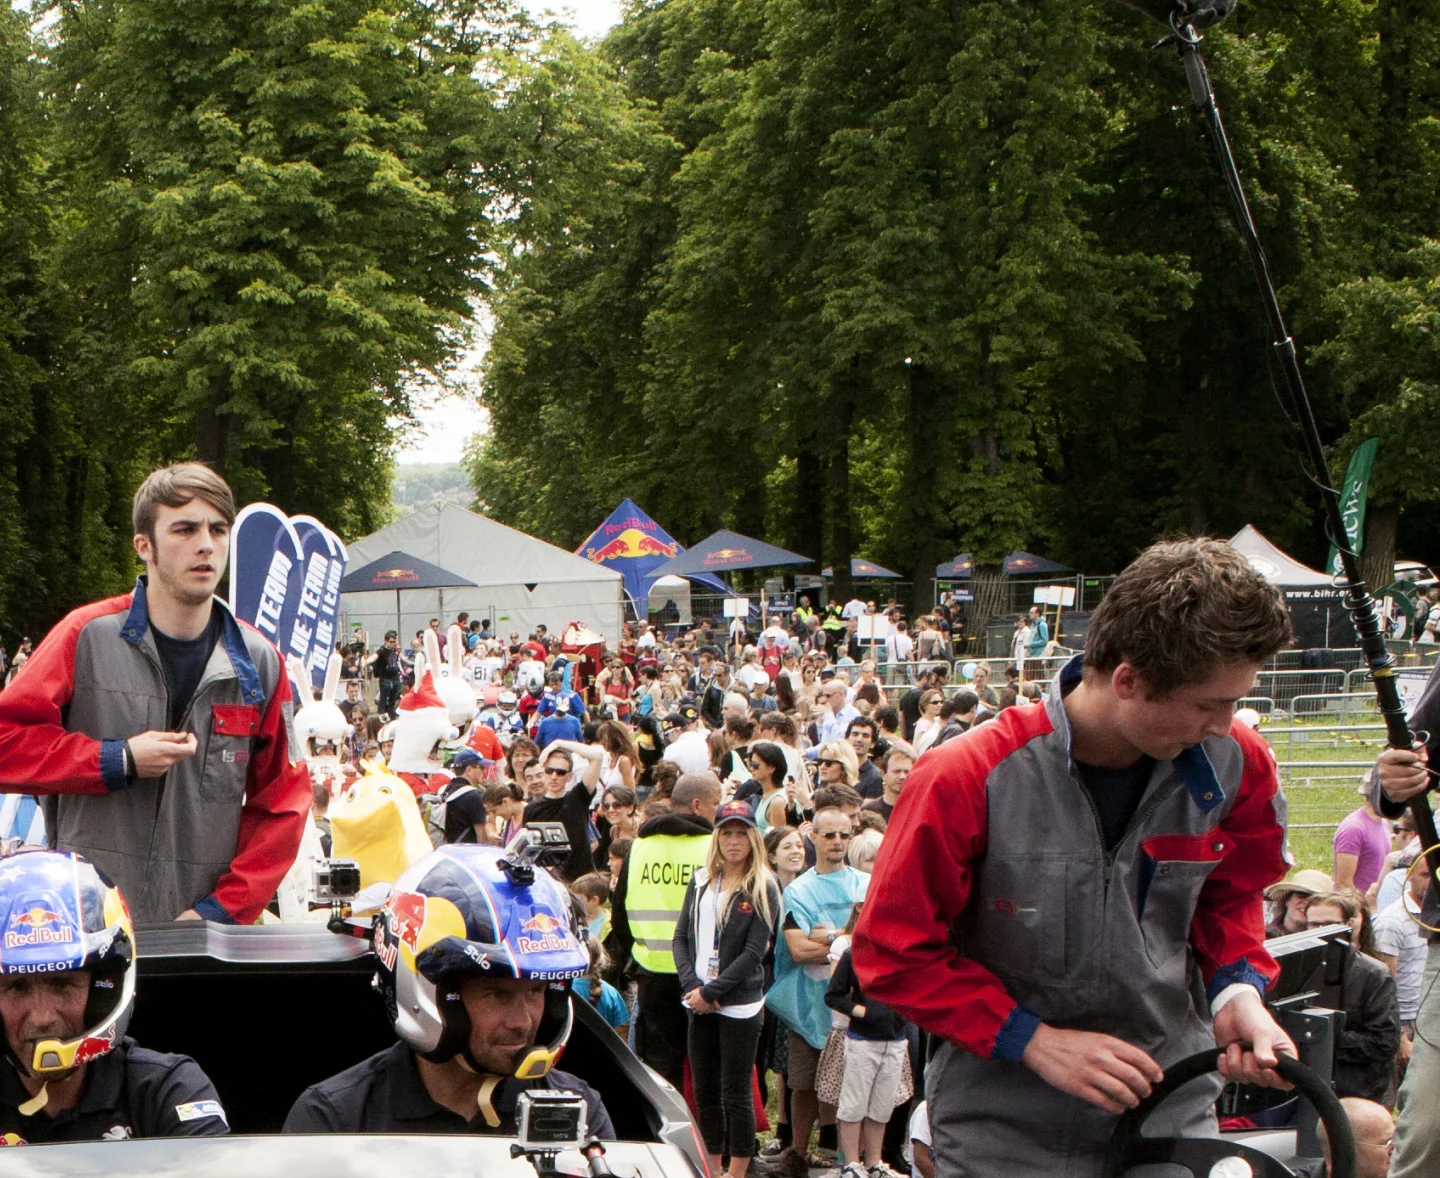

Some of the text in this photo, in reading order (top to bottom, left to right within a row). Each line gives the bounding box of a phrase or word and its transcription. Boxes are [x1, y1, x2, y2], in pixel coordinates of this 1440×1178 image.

[604, 517, 657, 536] Red Bull
[254, 549, 293, 635] TEAM
[297, 551, 329, 620] TEAM
[321, 558, 343, 617] TEAM
[5, 926, 72, 948] Red Bull
[518, 933, 578, 954] Red Bull
[8, 959, 75, 975] PEUGEOT
[464, 943, 493, 970] Stilo
[530, 968, 585, 980] PEUGEOT
